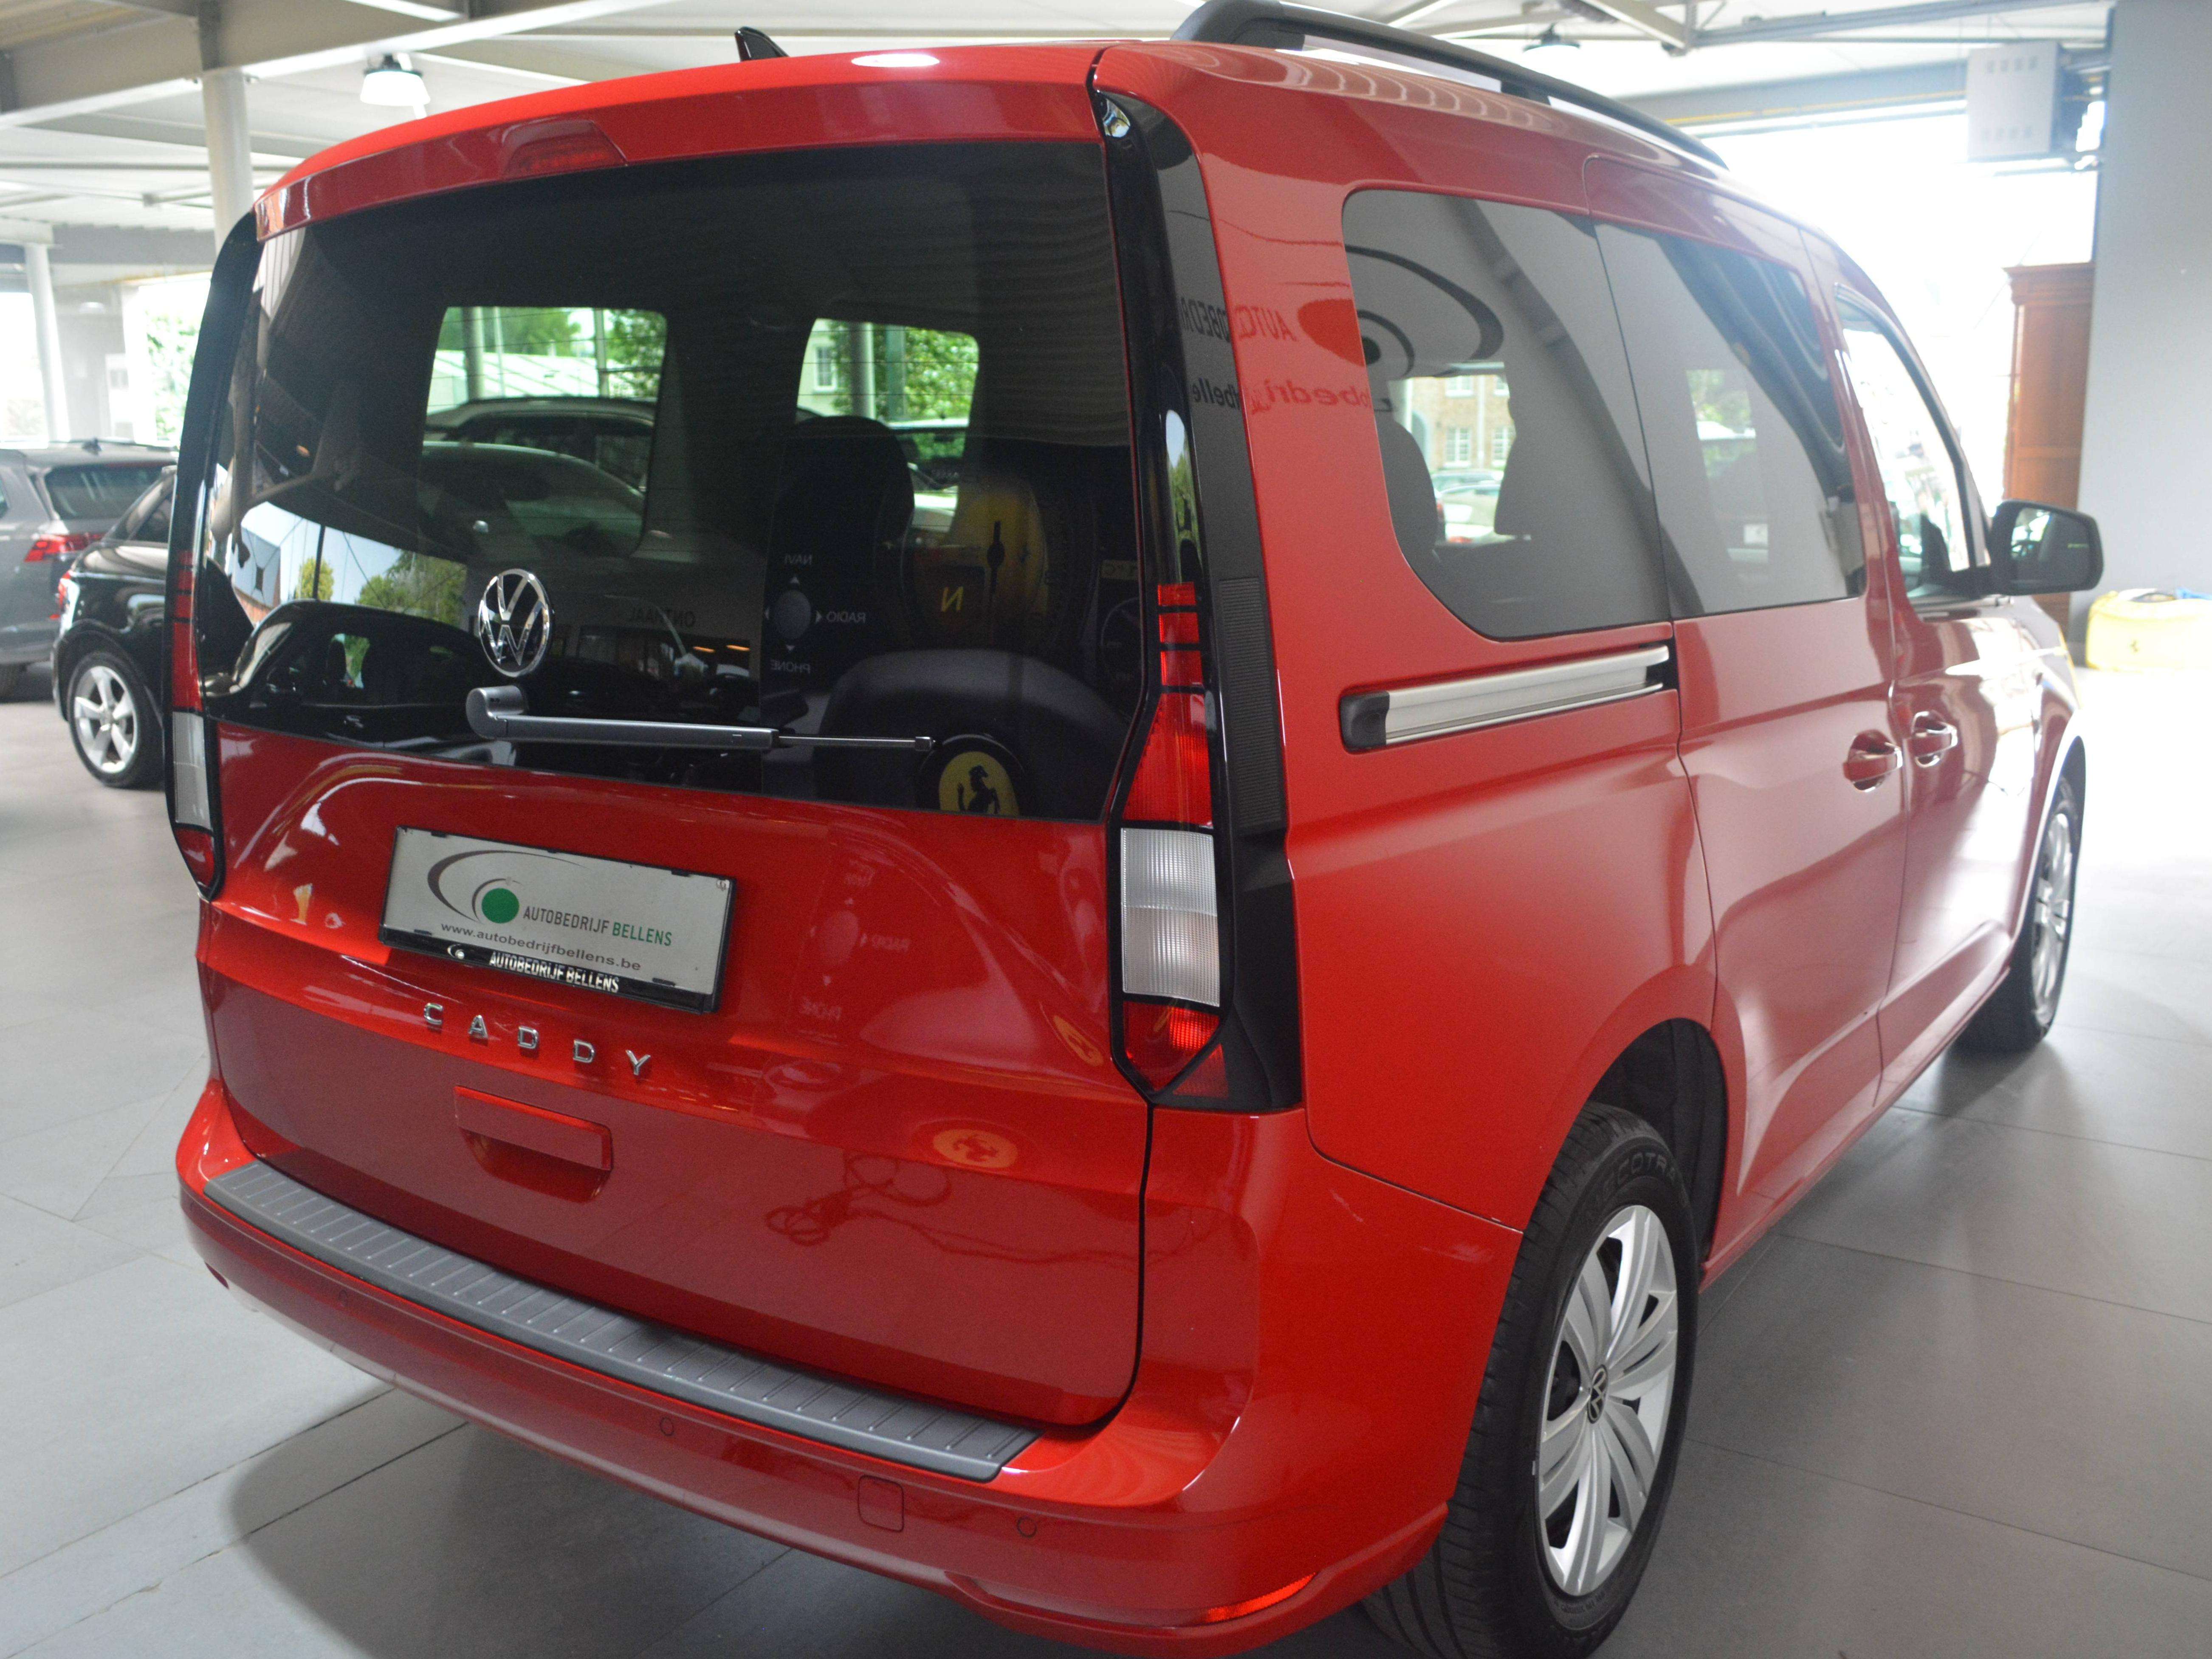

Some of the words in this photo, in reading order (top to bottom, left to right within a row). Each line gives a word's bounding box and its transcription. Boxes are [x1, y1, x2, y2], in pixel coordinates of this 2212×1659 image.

[441, 923, 641, 971] www.autobedrijfbellens.be
[523, 906, 609, 934] AUTOBEDRIJF
[612, 922, 672, 946] BELLENS
[489, 951, 565, 982] AUTOBEDRIJF
[565, 967, 620, 993] BELLENS
[424, 1002, 651, 1076] CADDY
